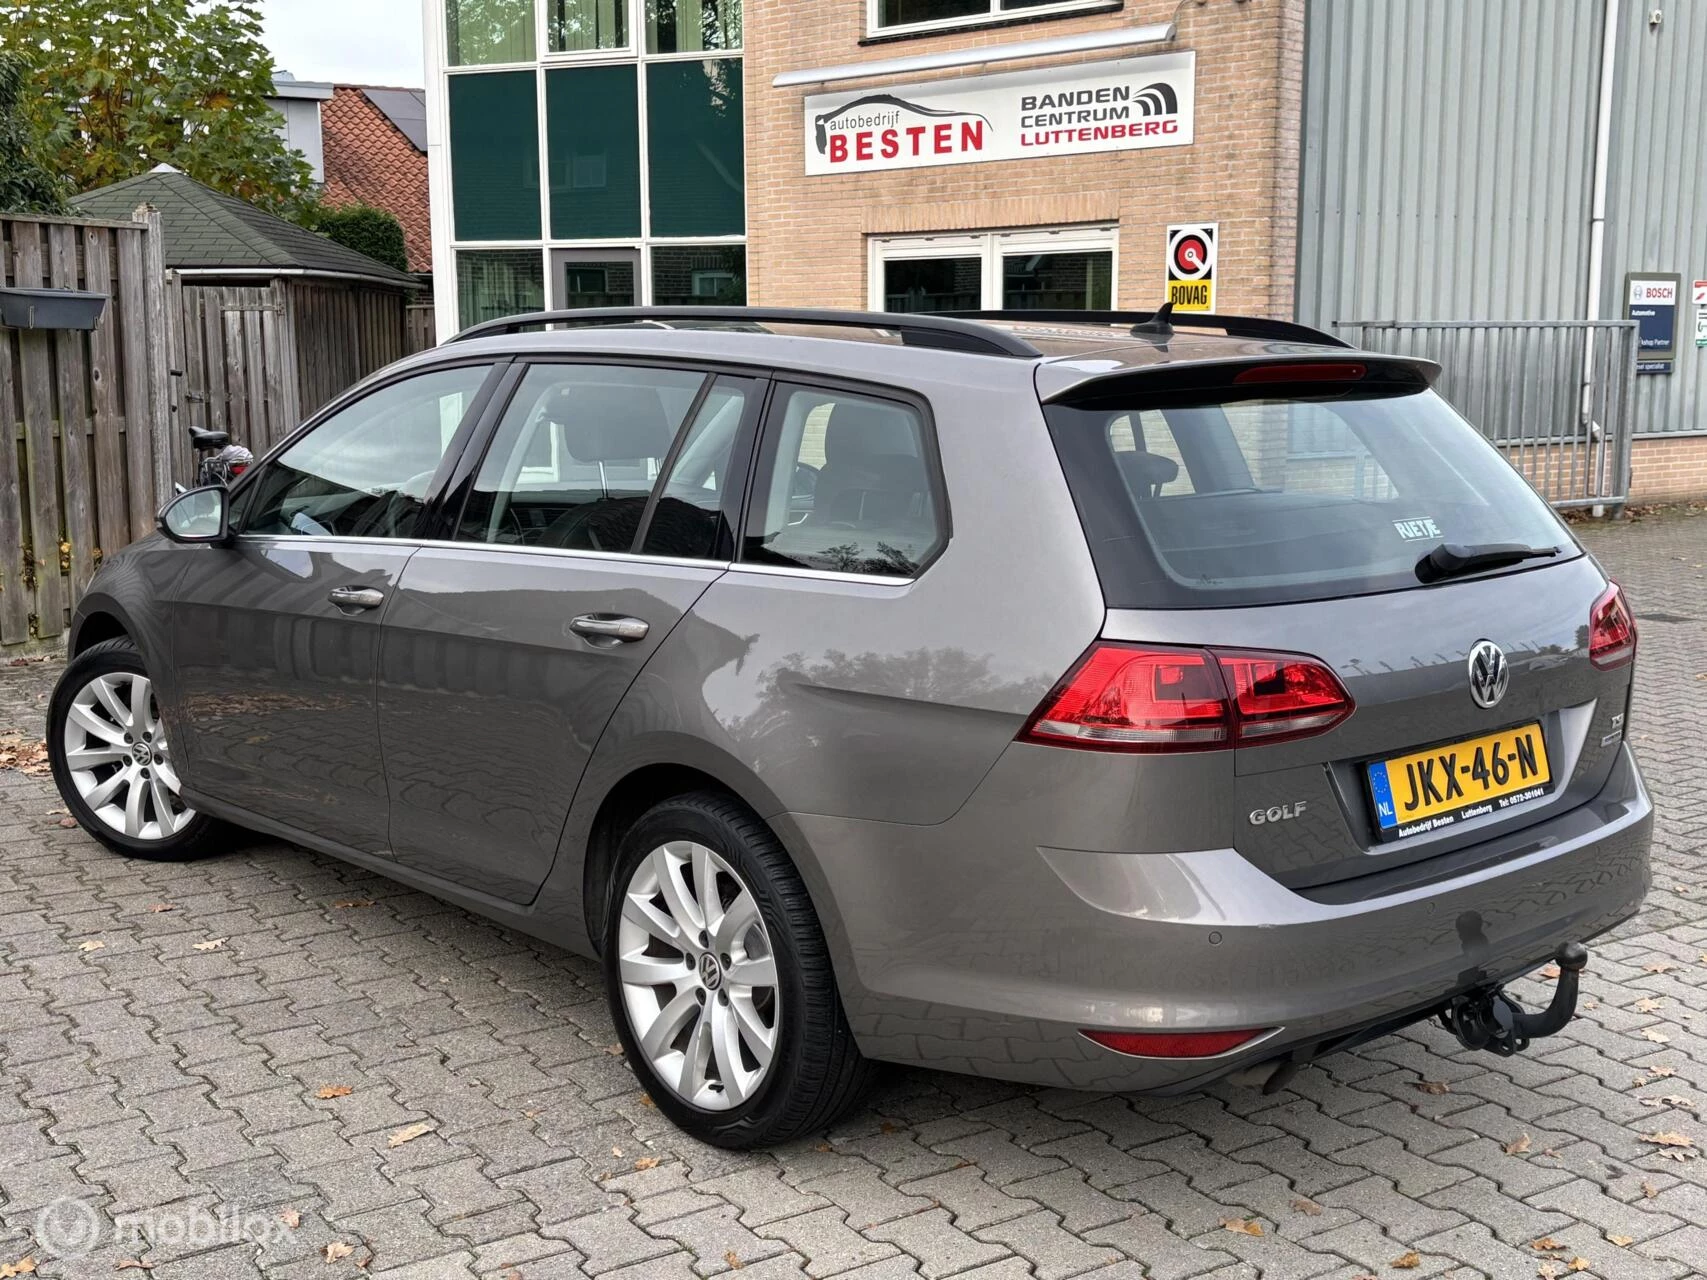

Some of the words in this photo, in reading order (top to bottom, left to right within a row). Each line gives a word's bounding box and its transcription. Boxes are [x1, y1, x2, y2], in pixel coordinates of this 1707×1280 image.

[1021, 86, 1130, 111] BANDEN
[830, 110, 900, 131] autobedrijf
[1021, 106, 1130, 128] CENTRUM
[830, 120, 983, 163] BESTEN
[1021, 120, 1178, 146] LUTTENBERG
[1171, 285, 1208, 305] BOVAG
[1646, 287, 1673, 298] BOSCH
[1404, 734, 1539, 811] JKX-46-N
[1249, 800, 1307, 825] GOLF
[1378, 802, 1393, 817] NL
[1398, 820, 1432, 838] Autobedrijf
[1433, 815, 1454, 829] Besten
[1461, 804, 1493, 820] Luttenberg
